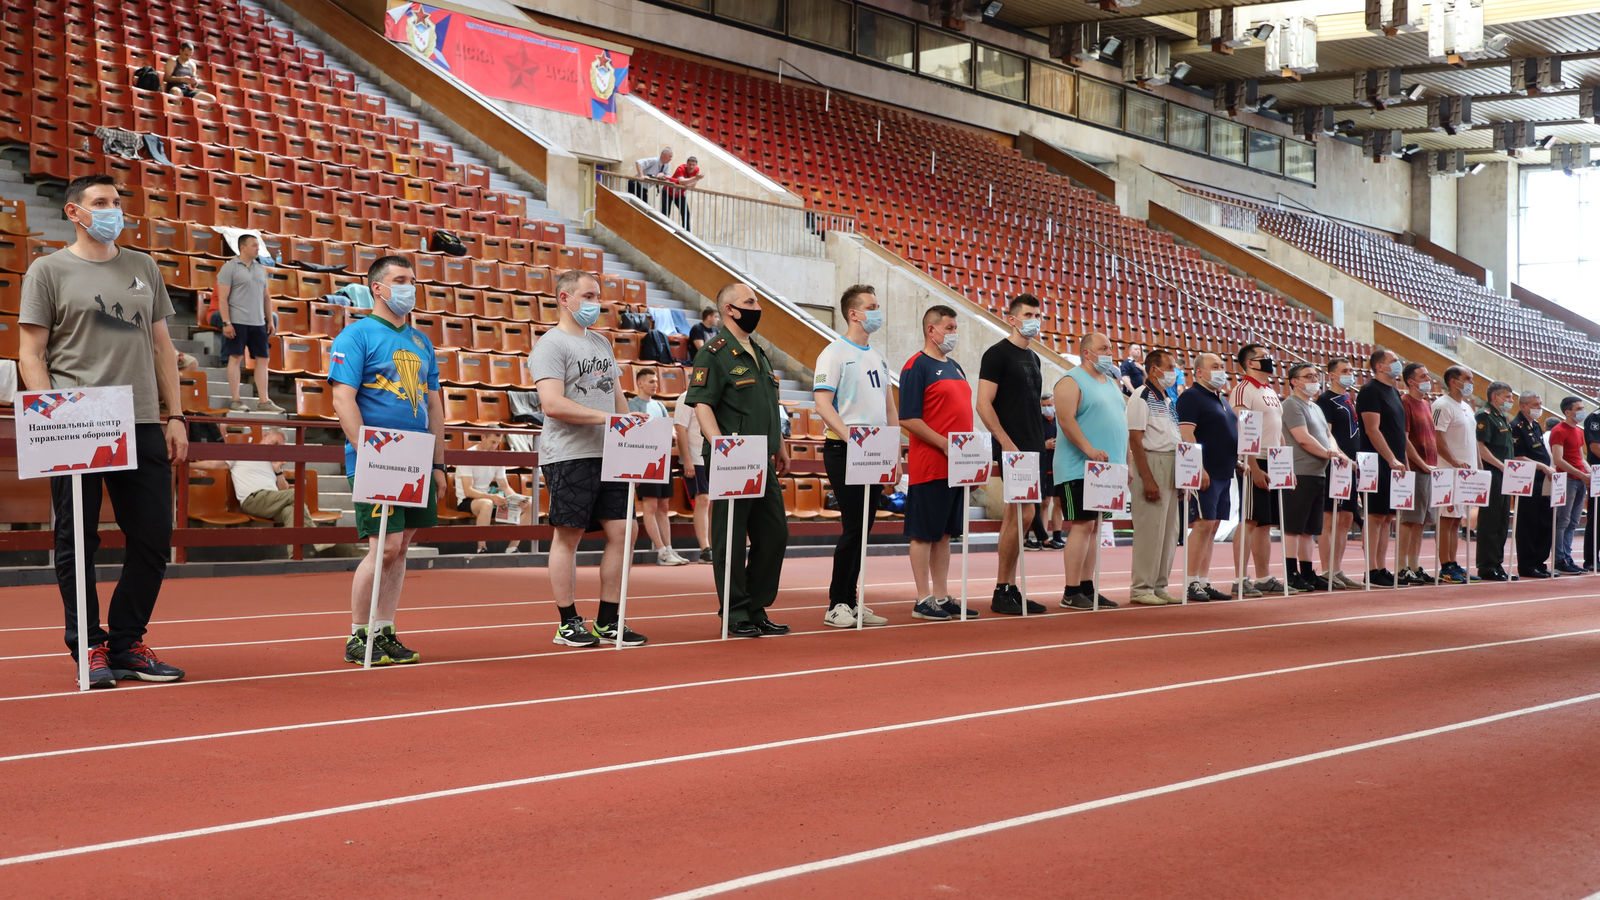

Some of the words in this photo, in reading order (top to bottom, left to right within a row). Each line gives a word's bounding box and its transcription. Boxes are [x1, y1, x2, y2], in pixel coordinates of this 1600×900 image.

[867, 369, 881, 388] 11
[28, 419, 95, 432] Национальный
[96, 419, 121, 430] центр
[29, 433, 80, 445] управления
[82, 430, 121, 441] обороной
[368, 461, 407, 473] Командование
